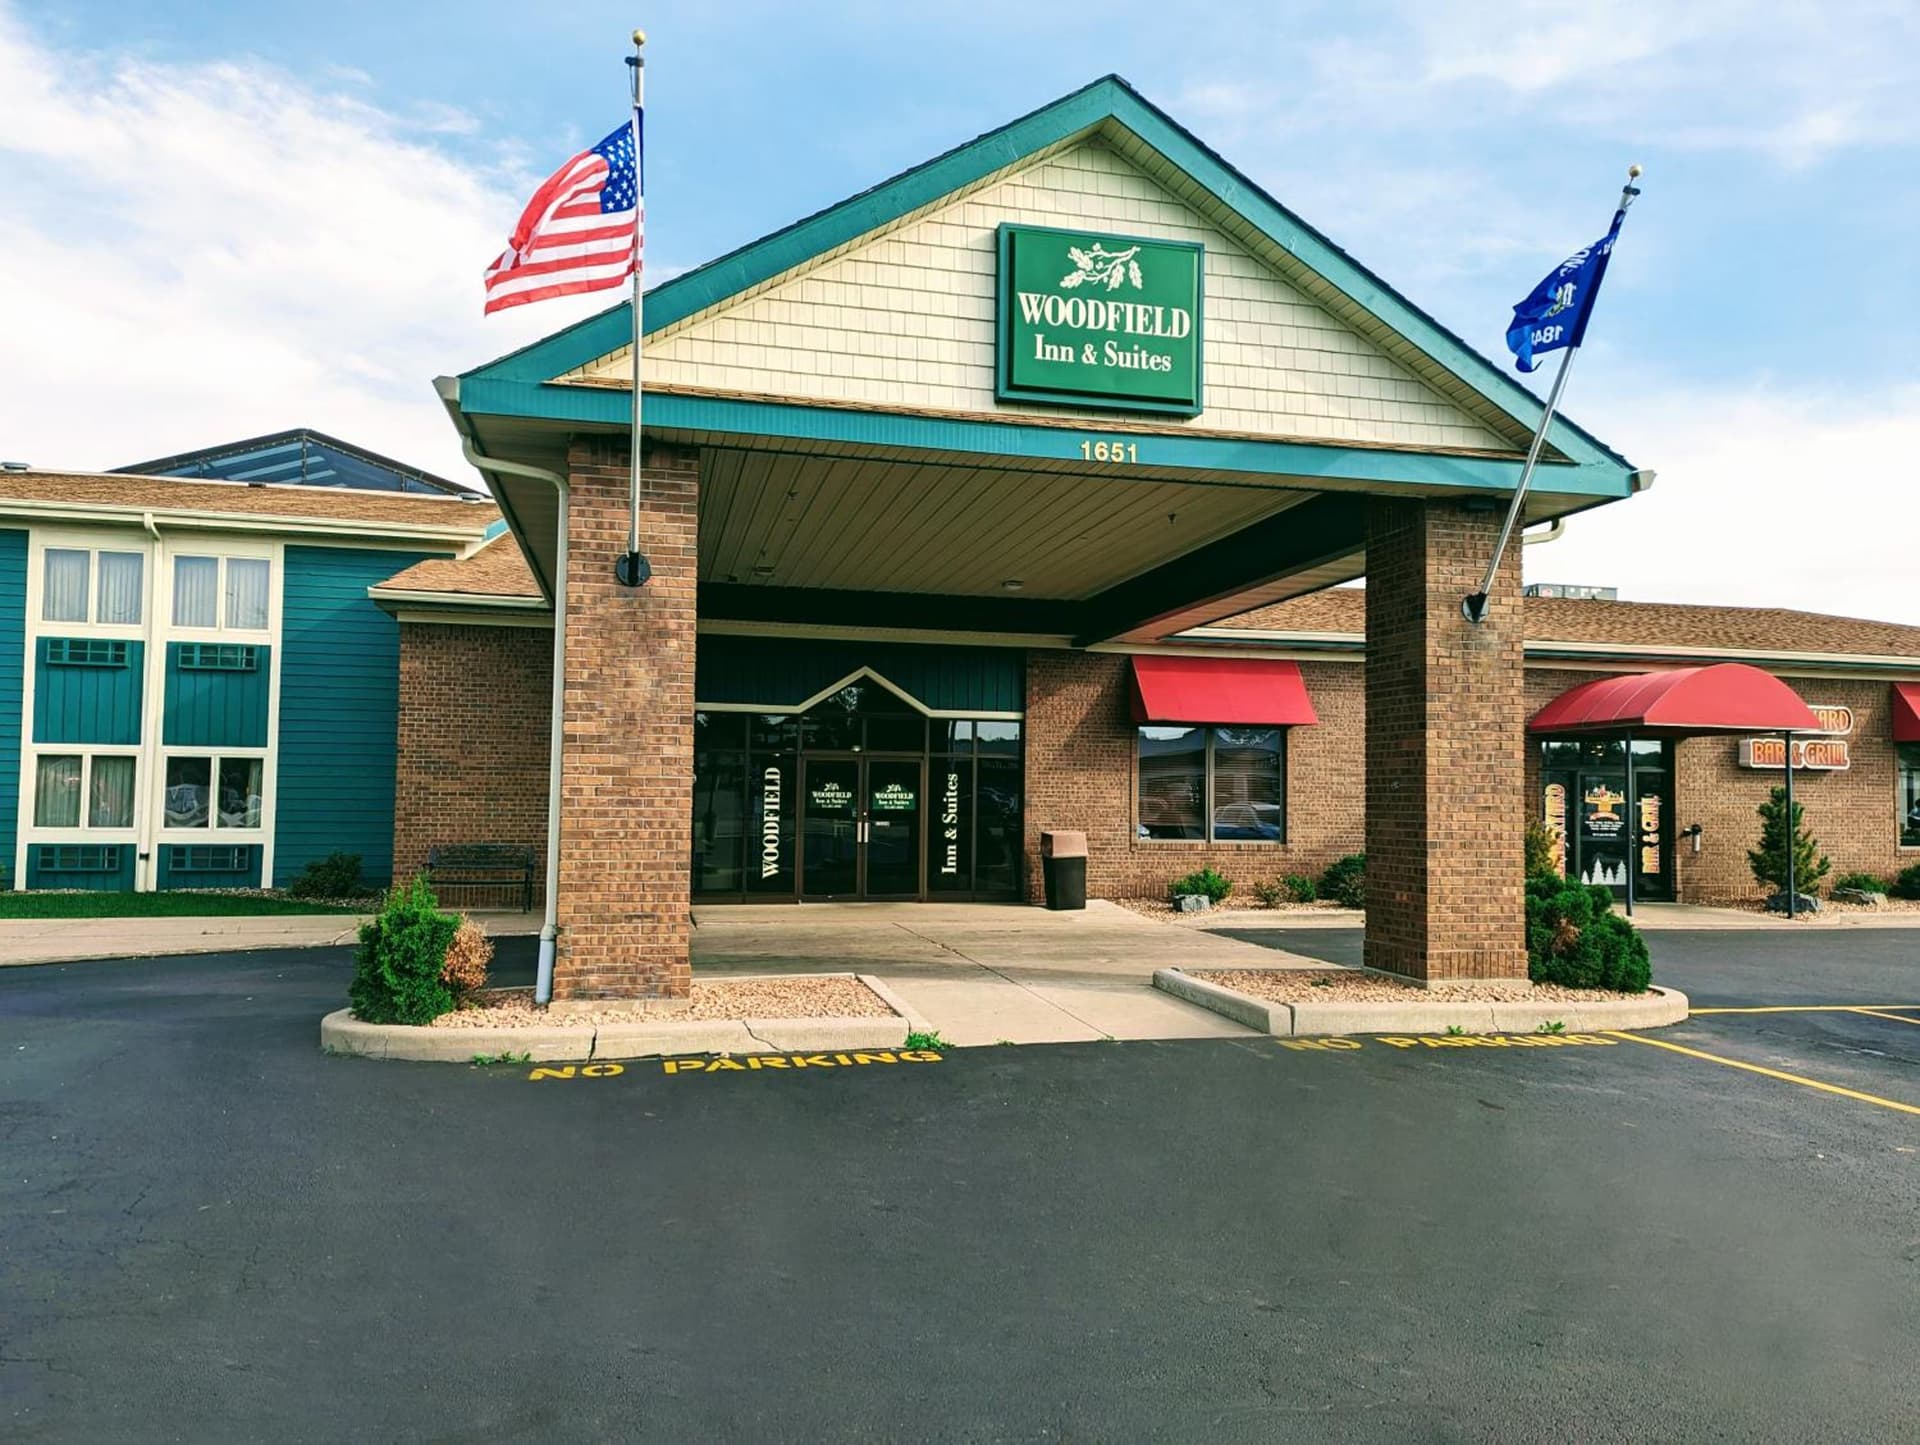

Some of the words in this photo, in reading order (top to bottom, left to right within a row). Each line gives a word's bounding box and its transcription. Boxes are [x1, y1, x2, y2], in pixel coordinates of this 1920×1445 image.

[1017, 292, 1191, 338] WOODFIELD
[1034, 334, 1075, 363] Inn
[1081, 343, 1097, 365] &
[1104, 340, 1172, 372] Suites
[1081, 440, 1137, 464] 1651
[1753, 742, 1786, 764] BAR
[1806, 743, 1847, 765] GRILL
[812, 791, 852, 799] WOODFIELD
[875, 792, 914, 800] WOODFIELD
[942, 773, 958, 824] Suites
[762, 767, 780, 879] WOODFIELD
[944, 827, 957, 840] &
[941, 845, 957, 874] Inn
[1642, 845, 1660, 874] BAR
[528, 1062, 624, 1081] NO
[663, 1050, 944, 1074] PARKING
